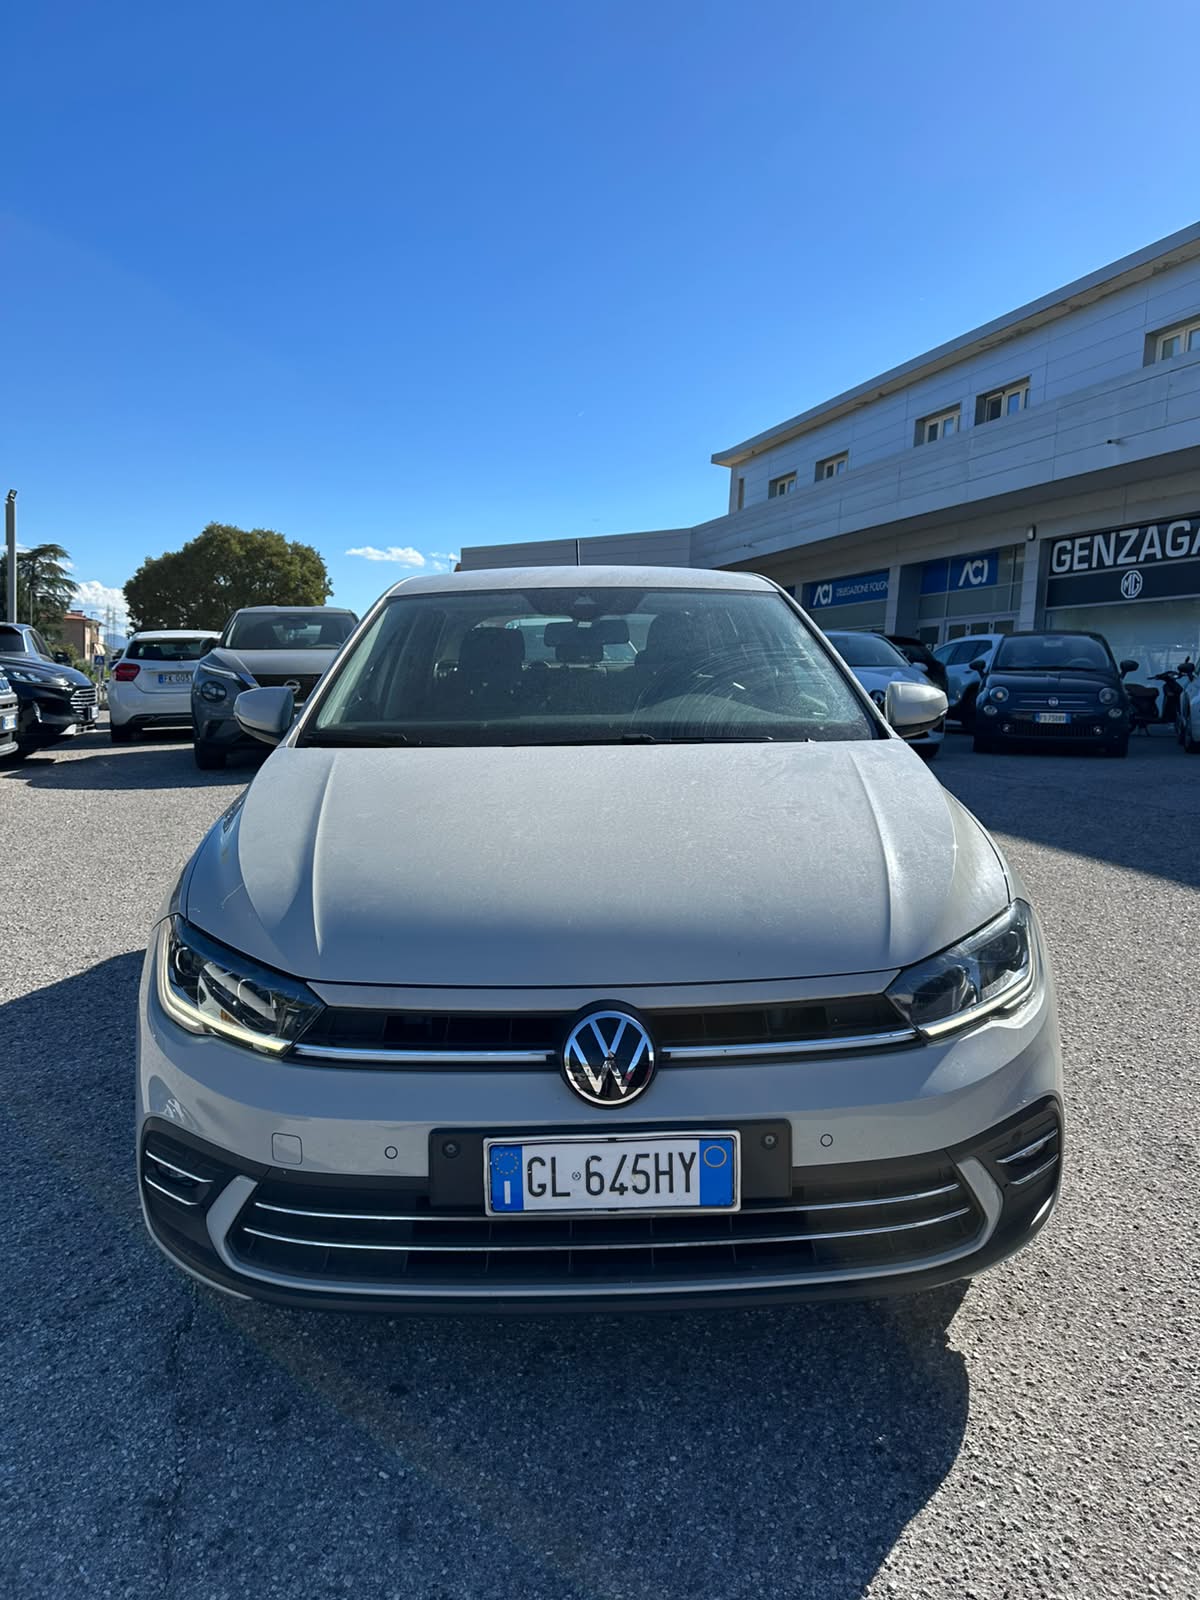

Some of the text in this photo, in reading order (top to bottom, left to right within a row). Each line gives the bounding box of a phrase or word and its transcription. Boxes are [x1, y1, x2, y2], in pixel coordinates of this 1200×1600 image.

[1122, 572, 1141, 596] MG
[527, 1151, 697, 1198] GL 645HY
